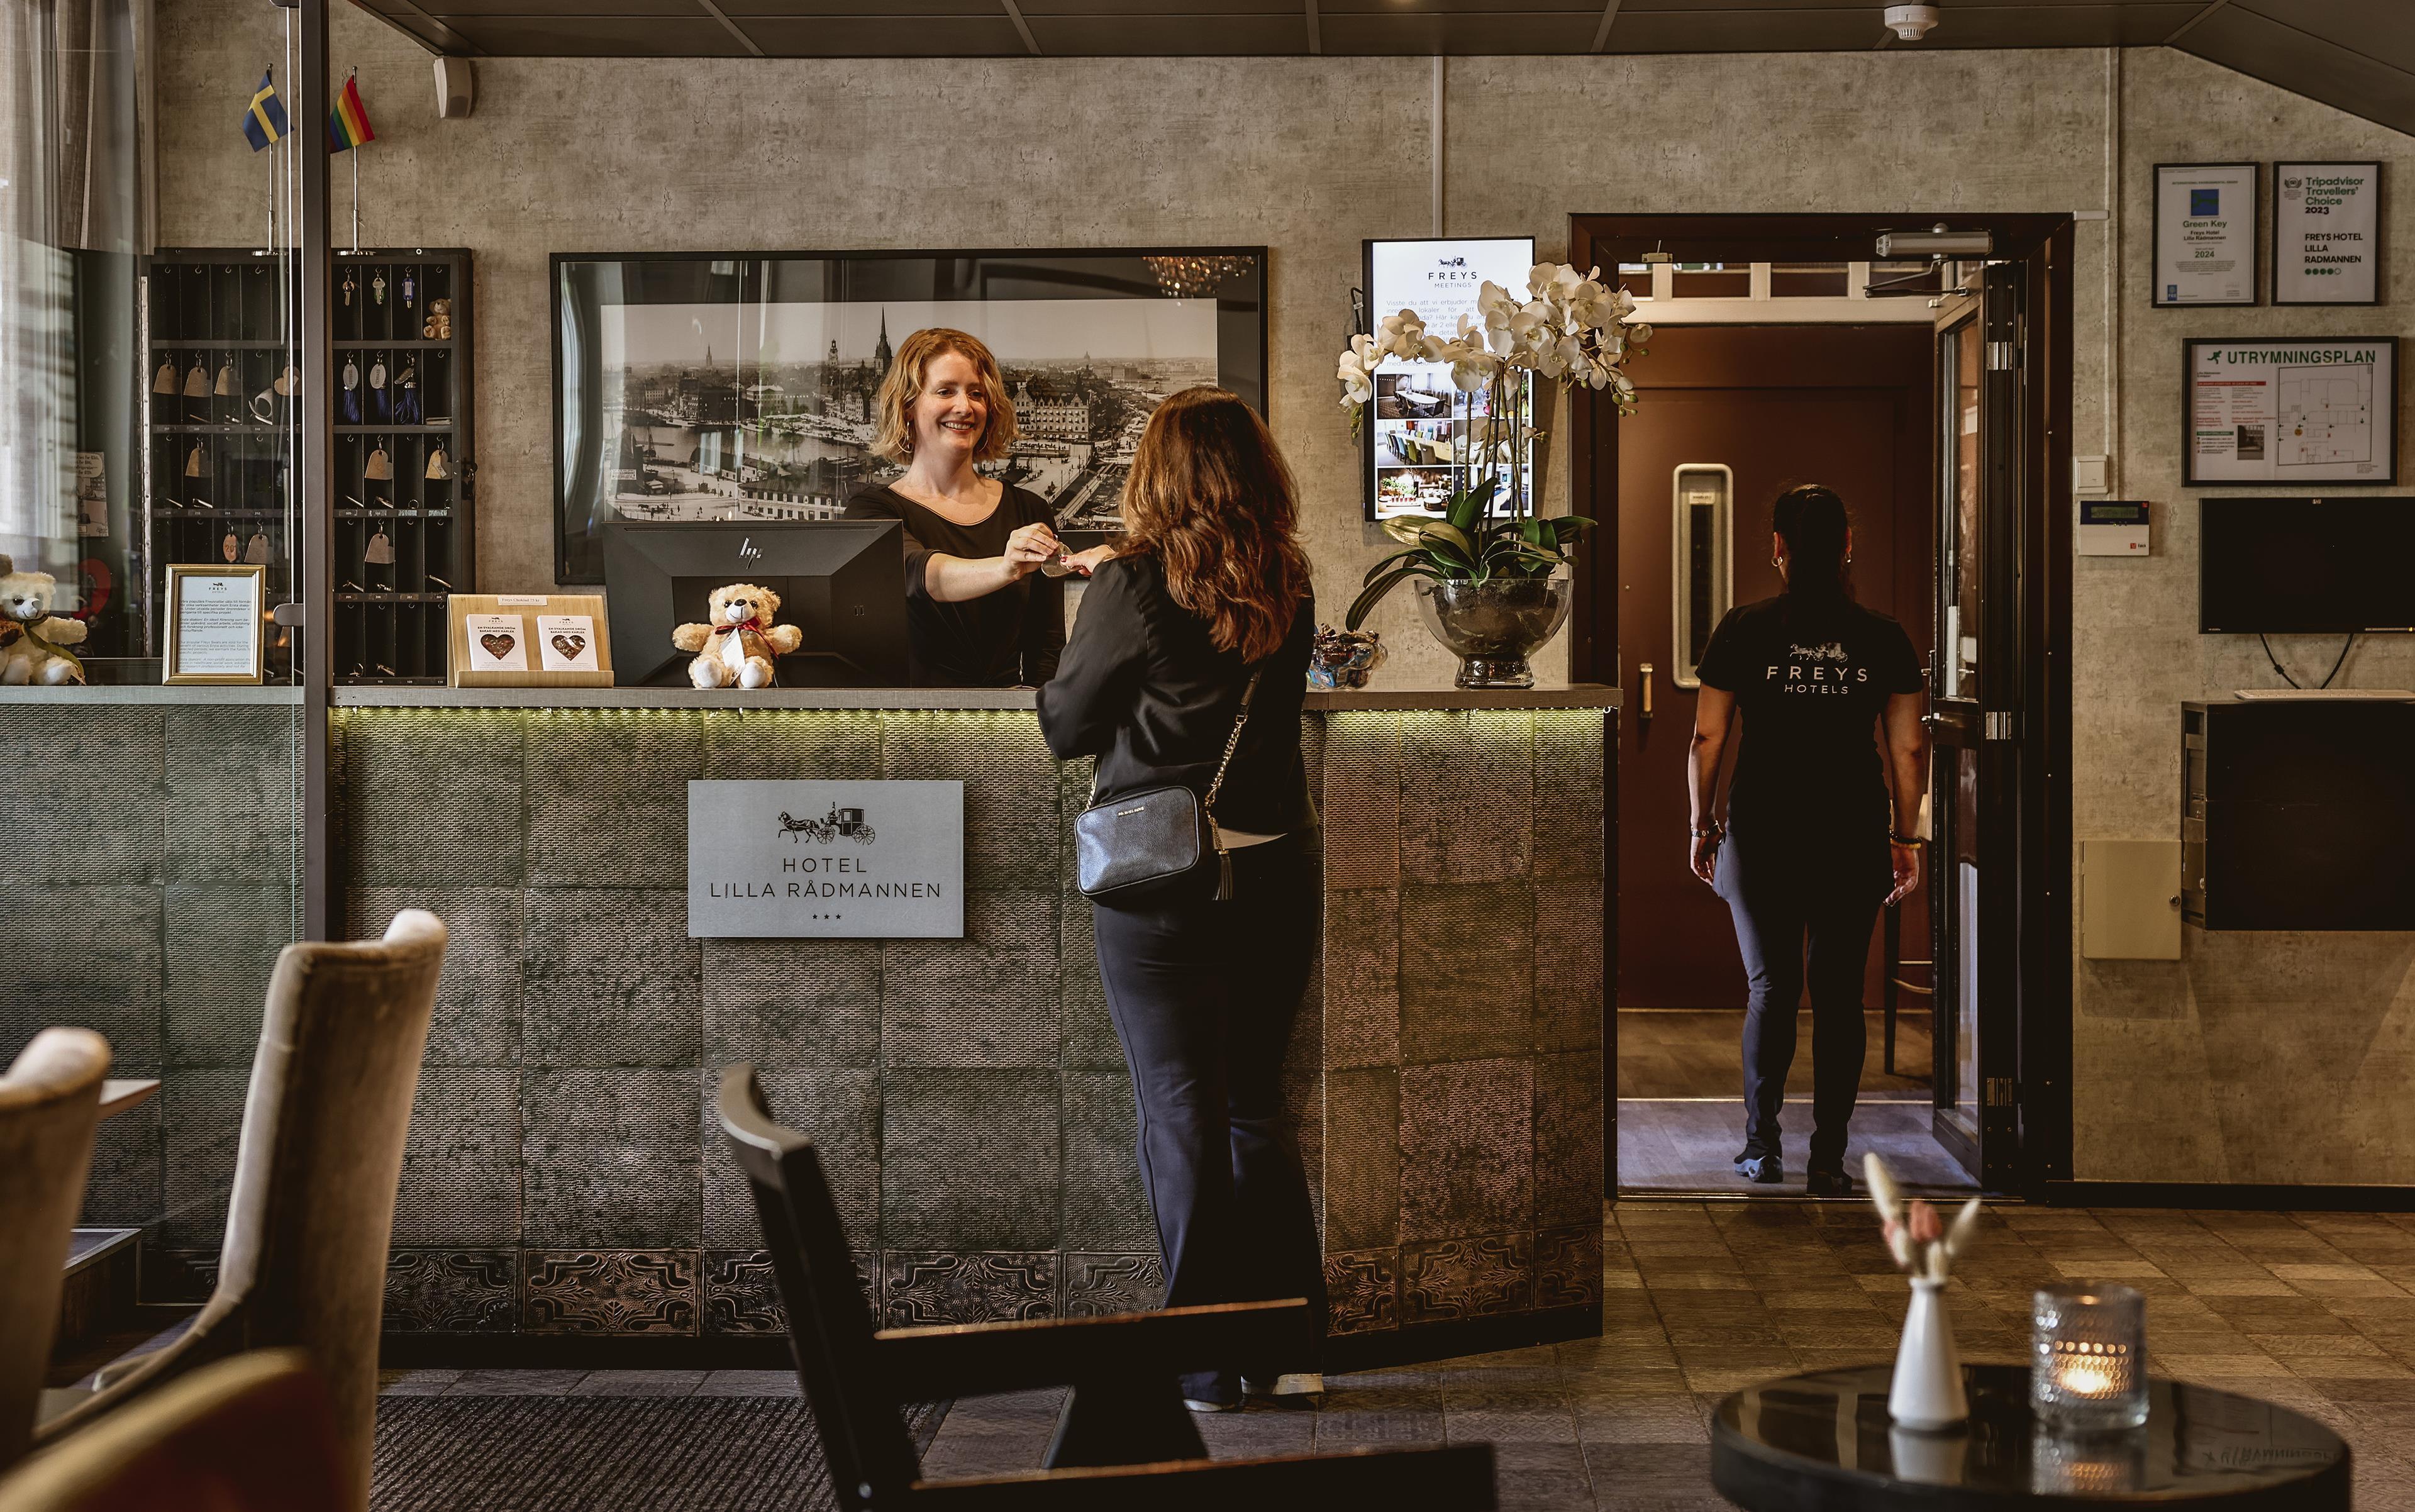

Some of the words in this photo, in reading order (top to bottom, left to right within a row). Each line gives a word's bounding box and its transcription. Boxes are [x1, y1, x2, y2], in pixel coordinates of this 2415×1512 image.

[2306, 177, 2364, 187] Tripadvisor
[2306, 196, 2343, 206] Choice
[2305, 233, 2332, 241] FREYS
[2333, 233, 2363, 241] HOTEL
[2305, 244, 2328, 252] LILLA
[2305, 255, 2362, 264] RADMANNEN
[1428, 272, 1477, 280] FREYS
[1440, 299, 1468, 308] erbjuder
[2228, 350, 2376, 364] UTRYMNINGSPLAN
[738, 537, 765, 569] hp
[1766, 666, 1867, 682] FREYS
[1784, 684, 1848, 694] HOTELS
[783, 858, 867, 873] HOTEL
[711, 882, 775, 898] LILLA
[787, 880, 941, 898] RÅDMANNEN
